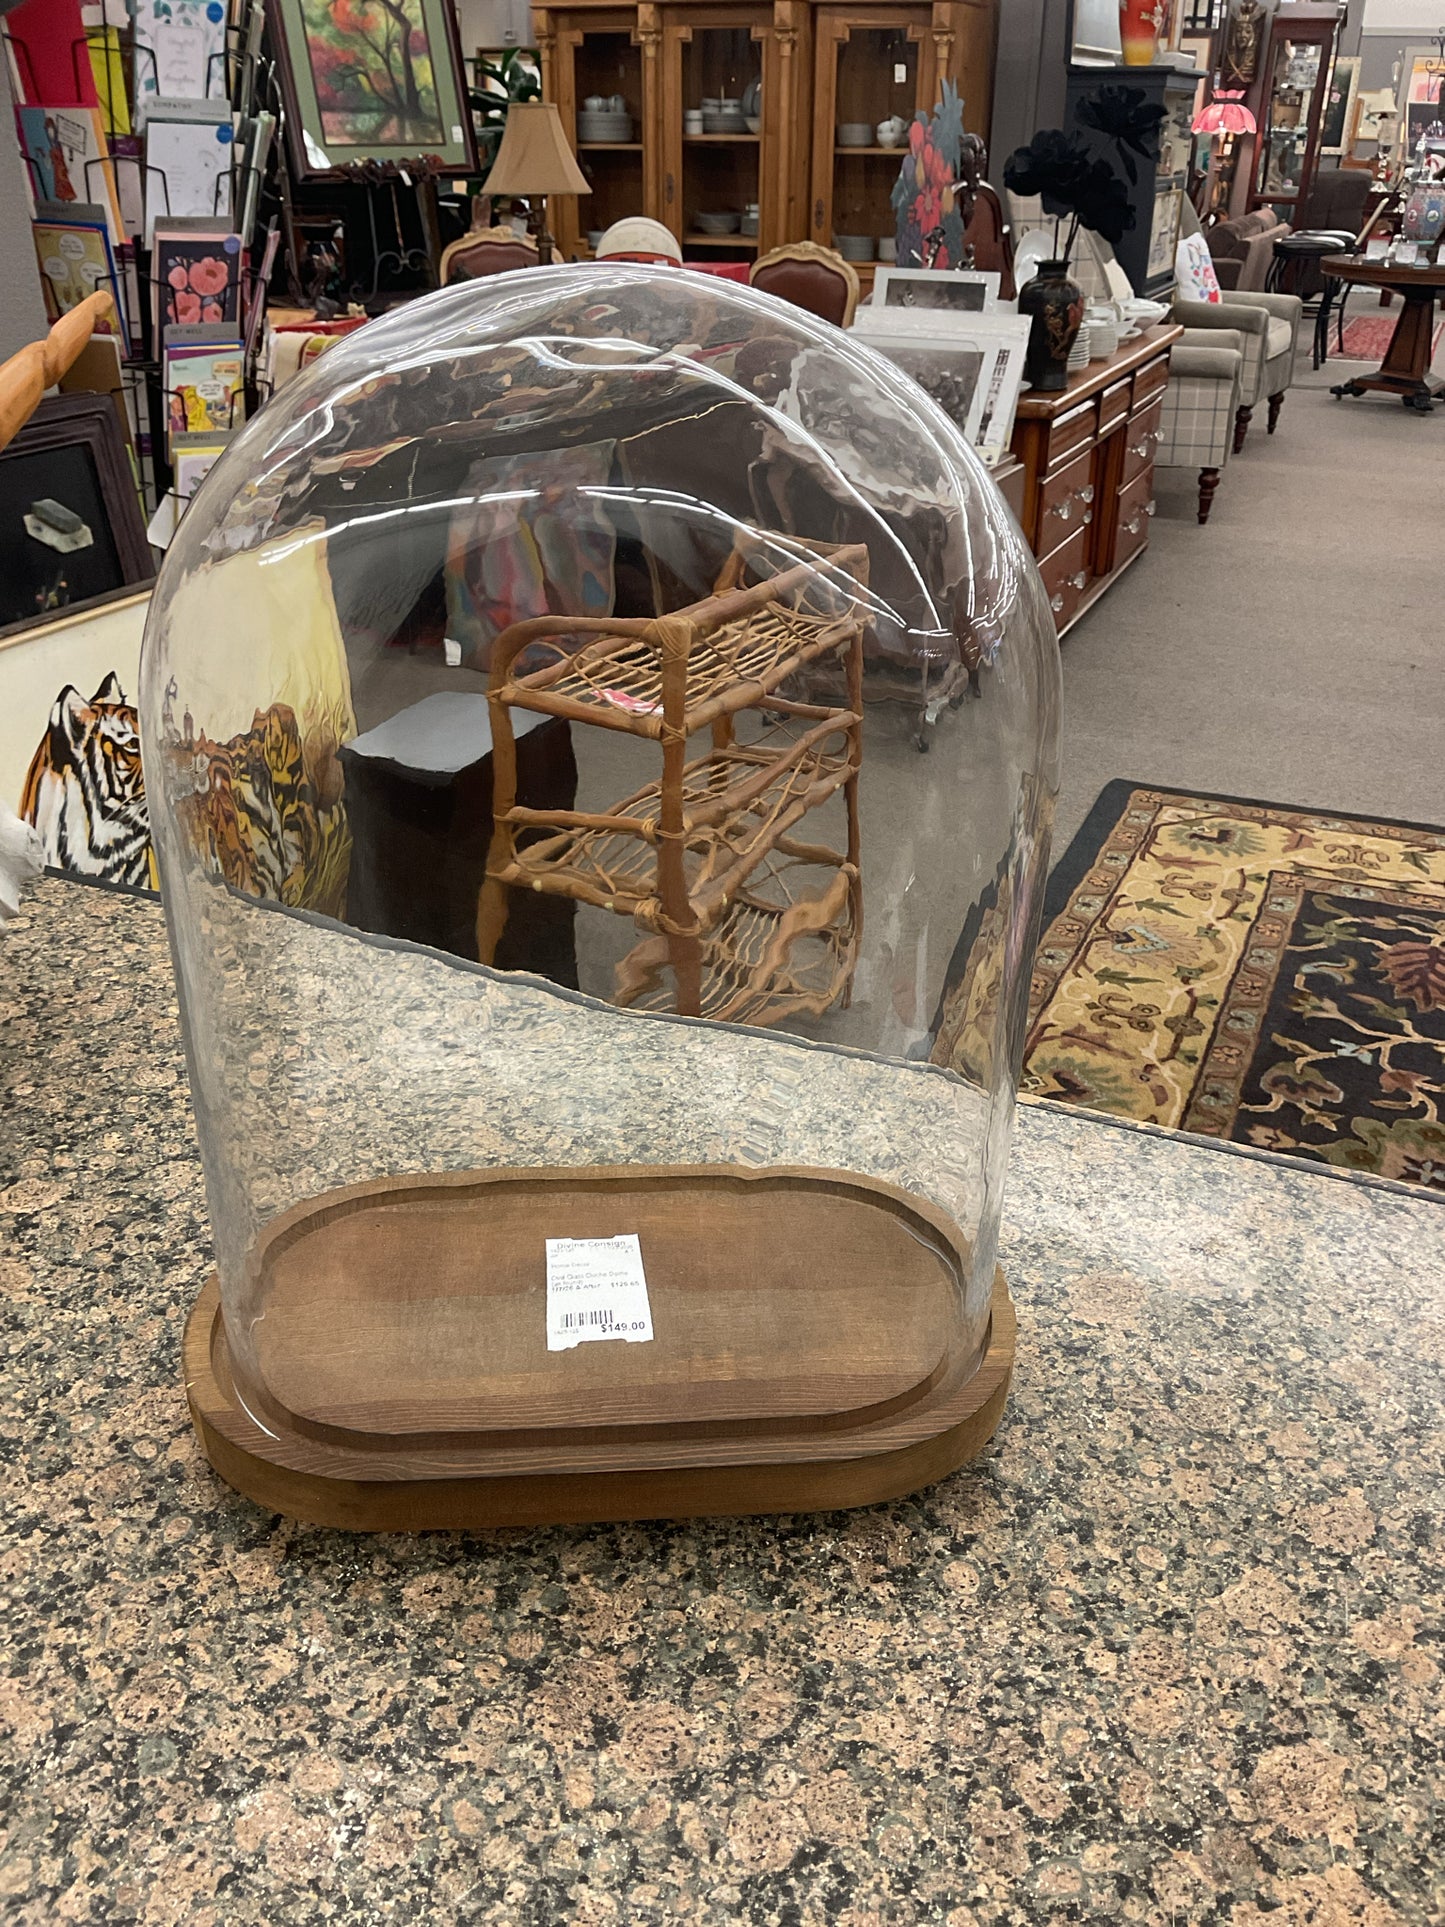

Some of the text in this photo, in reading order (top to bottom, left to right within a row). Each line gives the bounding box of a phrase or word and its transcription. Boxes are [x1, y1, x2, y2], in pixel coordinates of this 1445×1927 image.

[557, 1241, 585, 1250] Divine
[588, 1240, 626, 1249] Consign
[601, 1321, 646, 1333] $149.00
